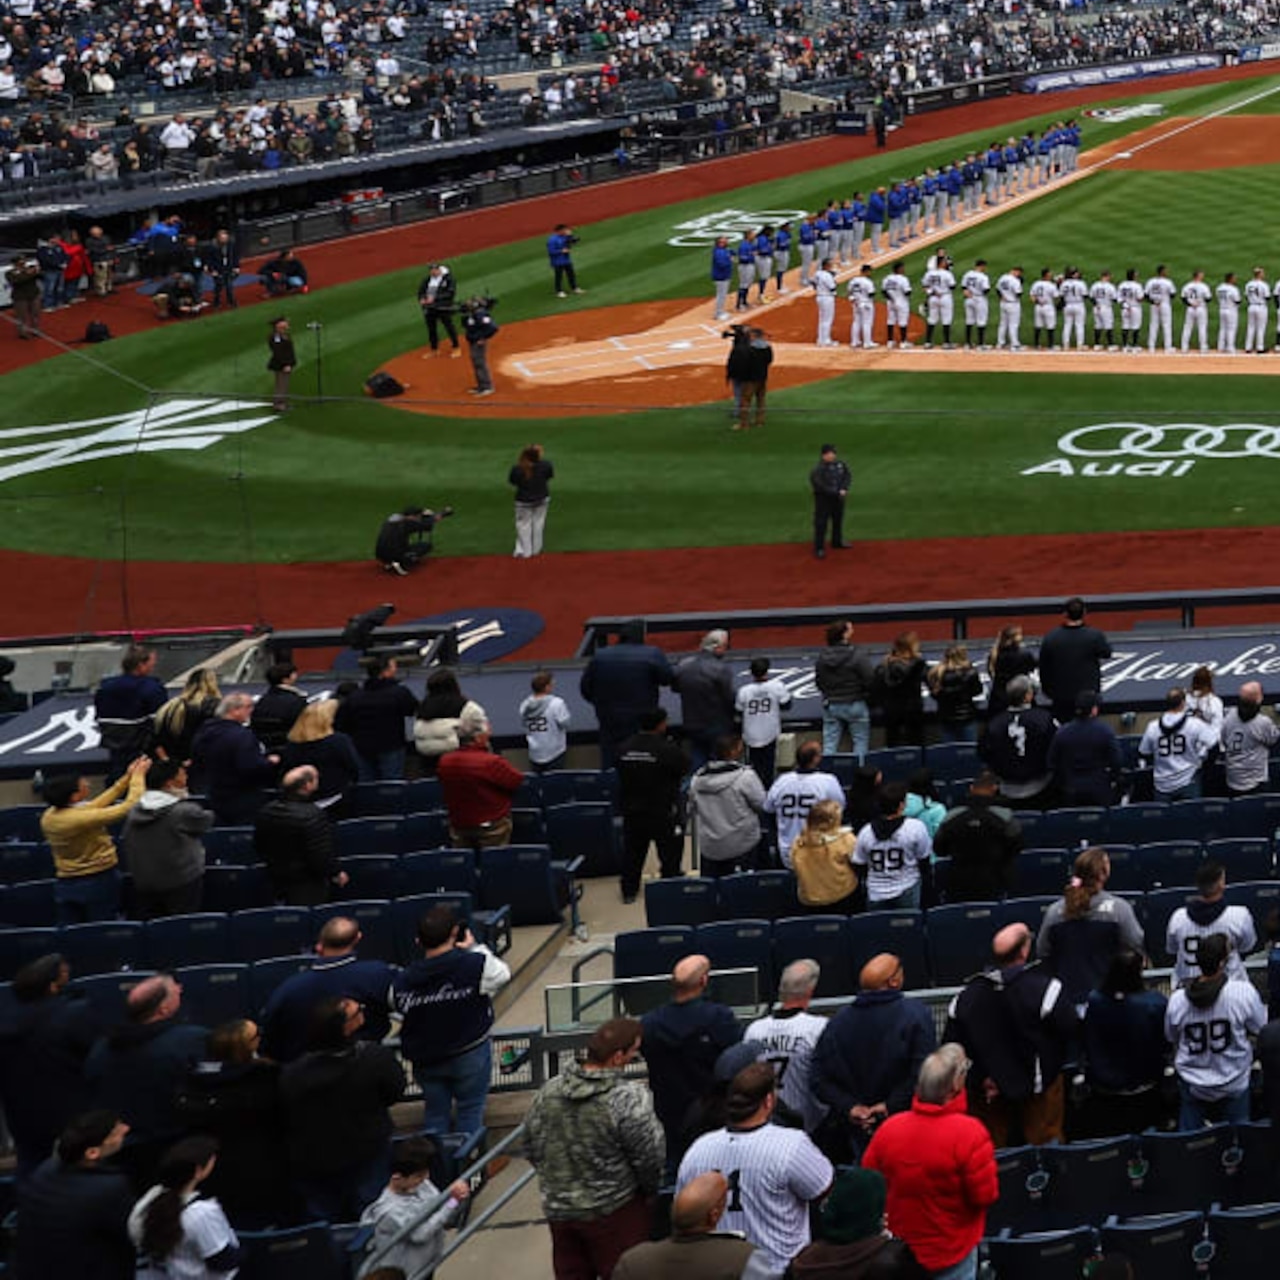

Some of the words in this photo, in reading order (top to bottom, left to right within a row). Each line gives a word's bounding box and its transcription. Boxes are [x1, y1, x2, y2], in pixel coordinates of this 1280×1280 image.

[1022, 458, 1196, 478] Audi
[748, 698, 771, 716] 99
[528, 718, 549, 733] 22
[1158, 734, 1186, 757] 99
[1232, 732, 1244, 752] 2
[781, 794, 816, 819] 25
[870, 847, 904, 873] 99
[1184, 1018, 1231, 1055] 99
